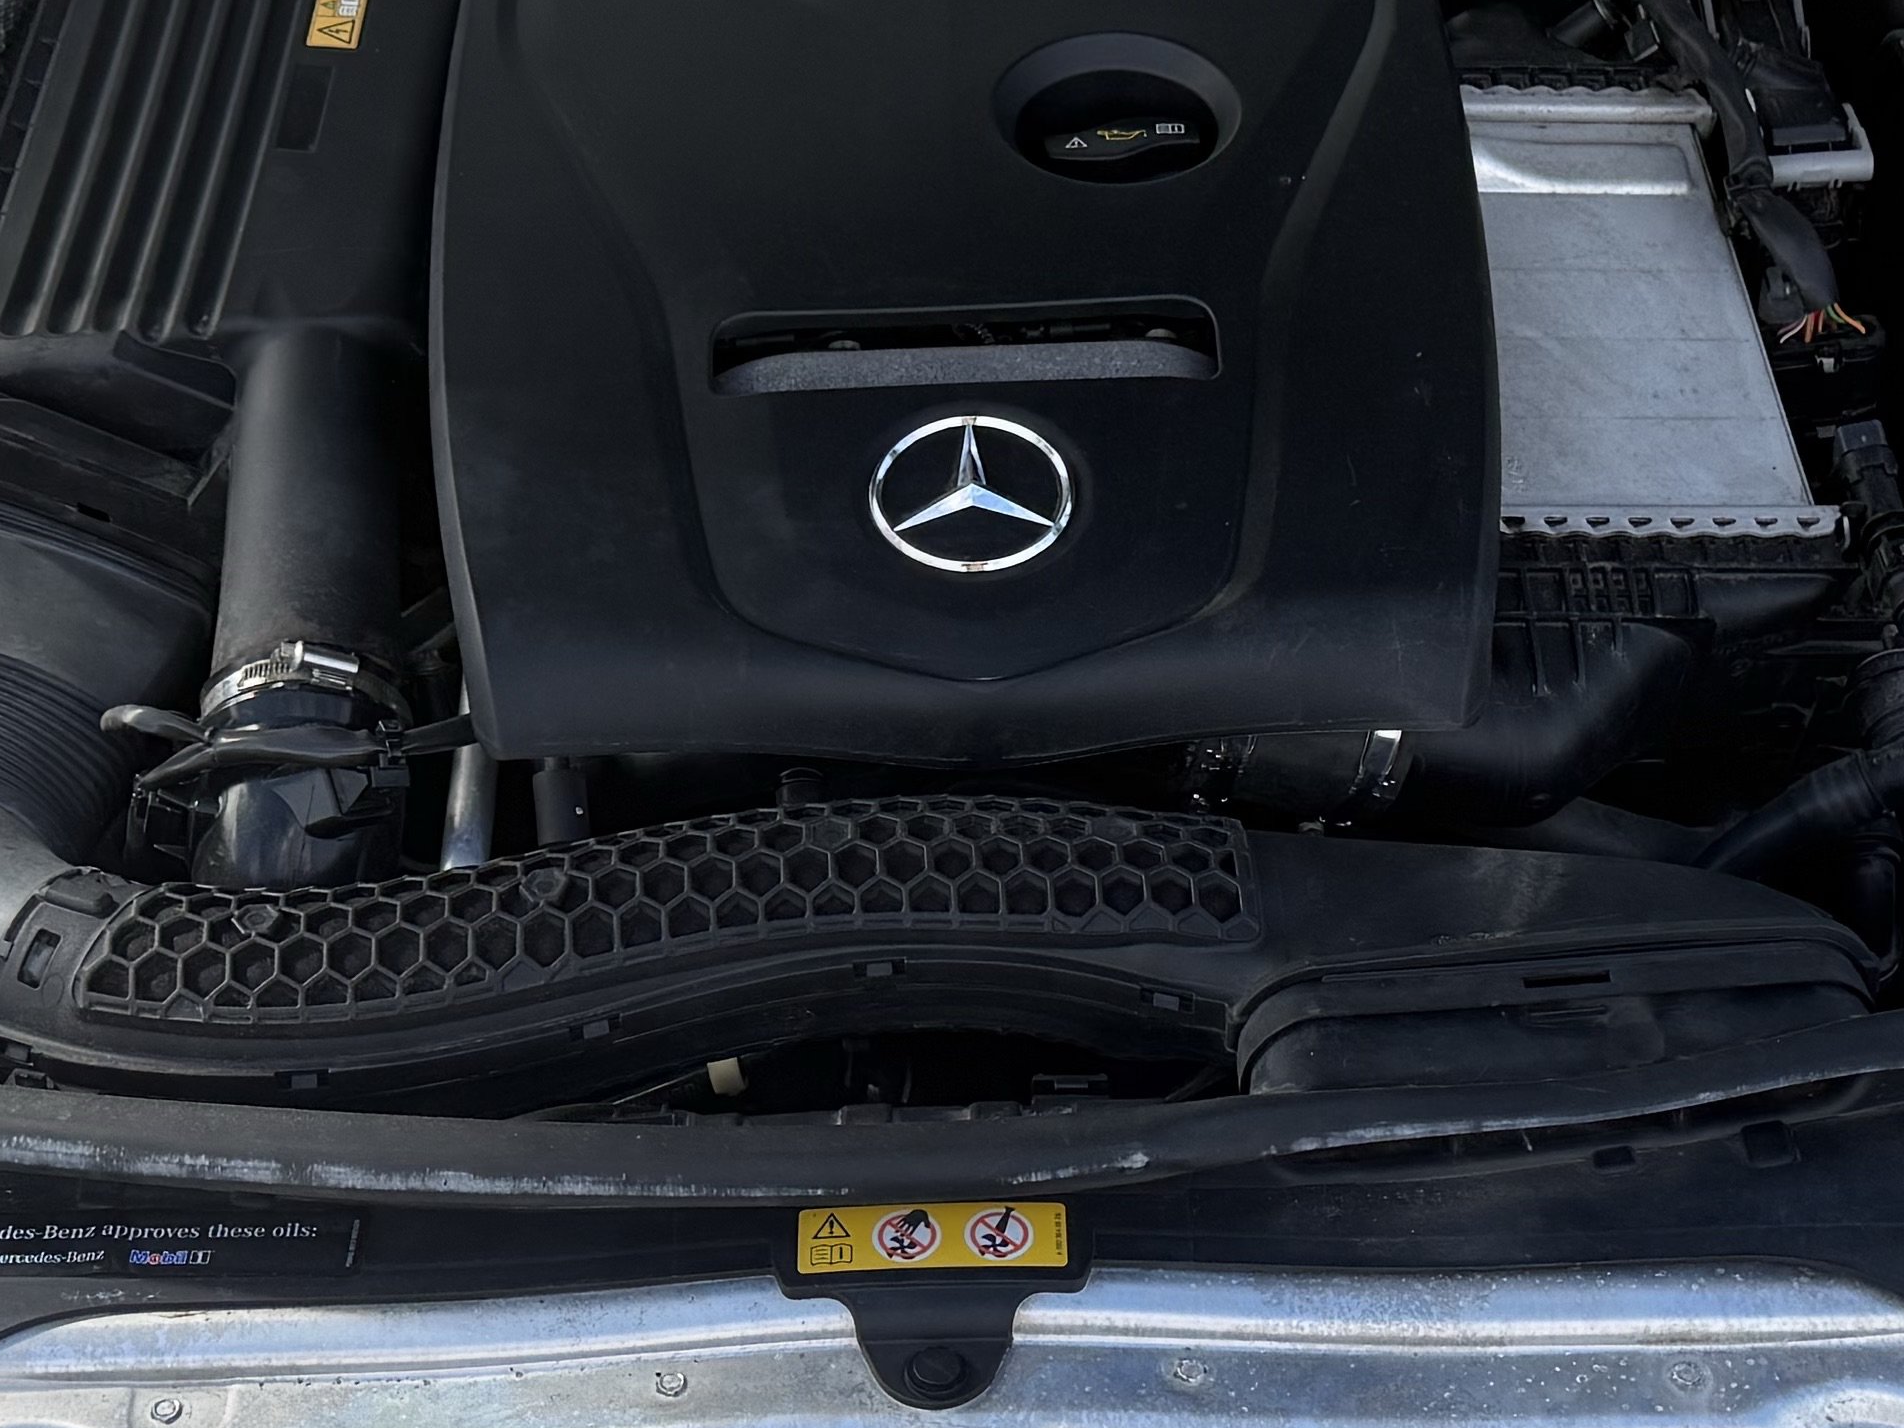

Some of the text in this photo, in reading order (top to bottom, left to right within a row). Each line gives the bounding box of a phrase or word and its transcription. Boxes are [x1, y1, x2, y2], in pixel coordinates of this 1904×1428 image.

[101, 1224, 200, 1241] approves
[207, 1223, 266, 1238] these
[272, 1222, 318, 1238] oils:
[129, 1249, 188, 1265] Mobil
